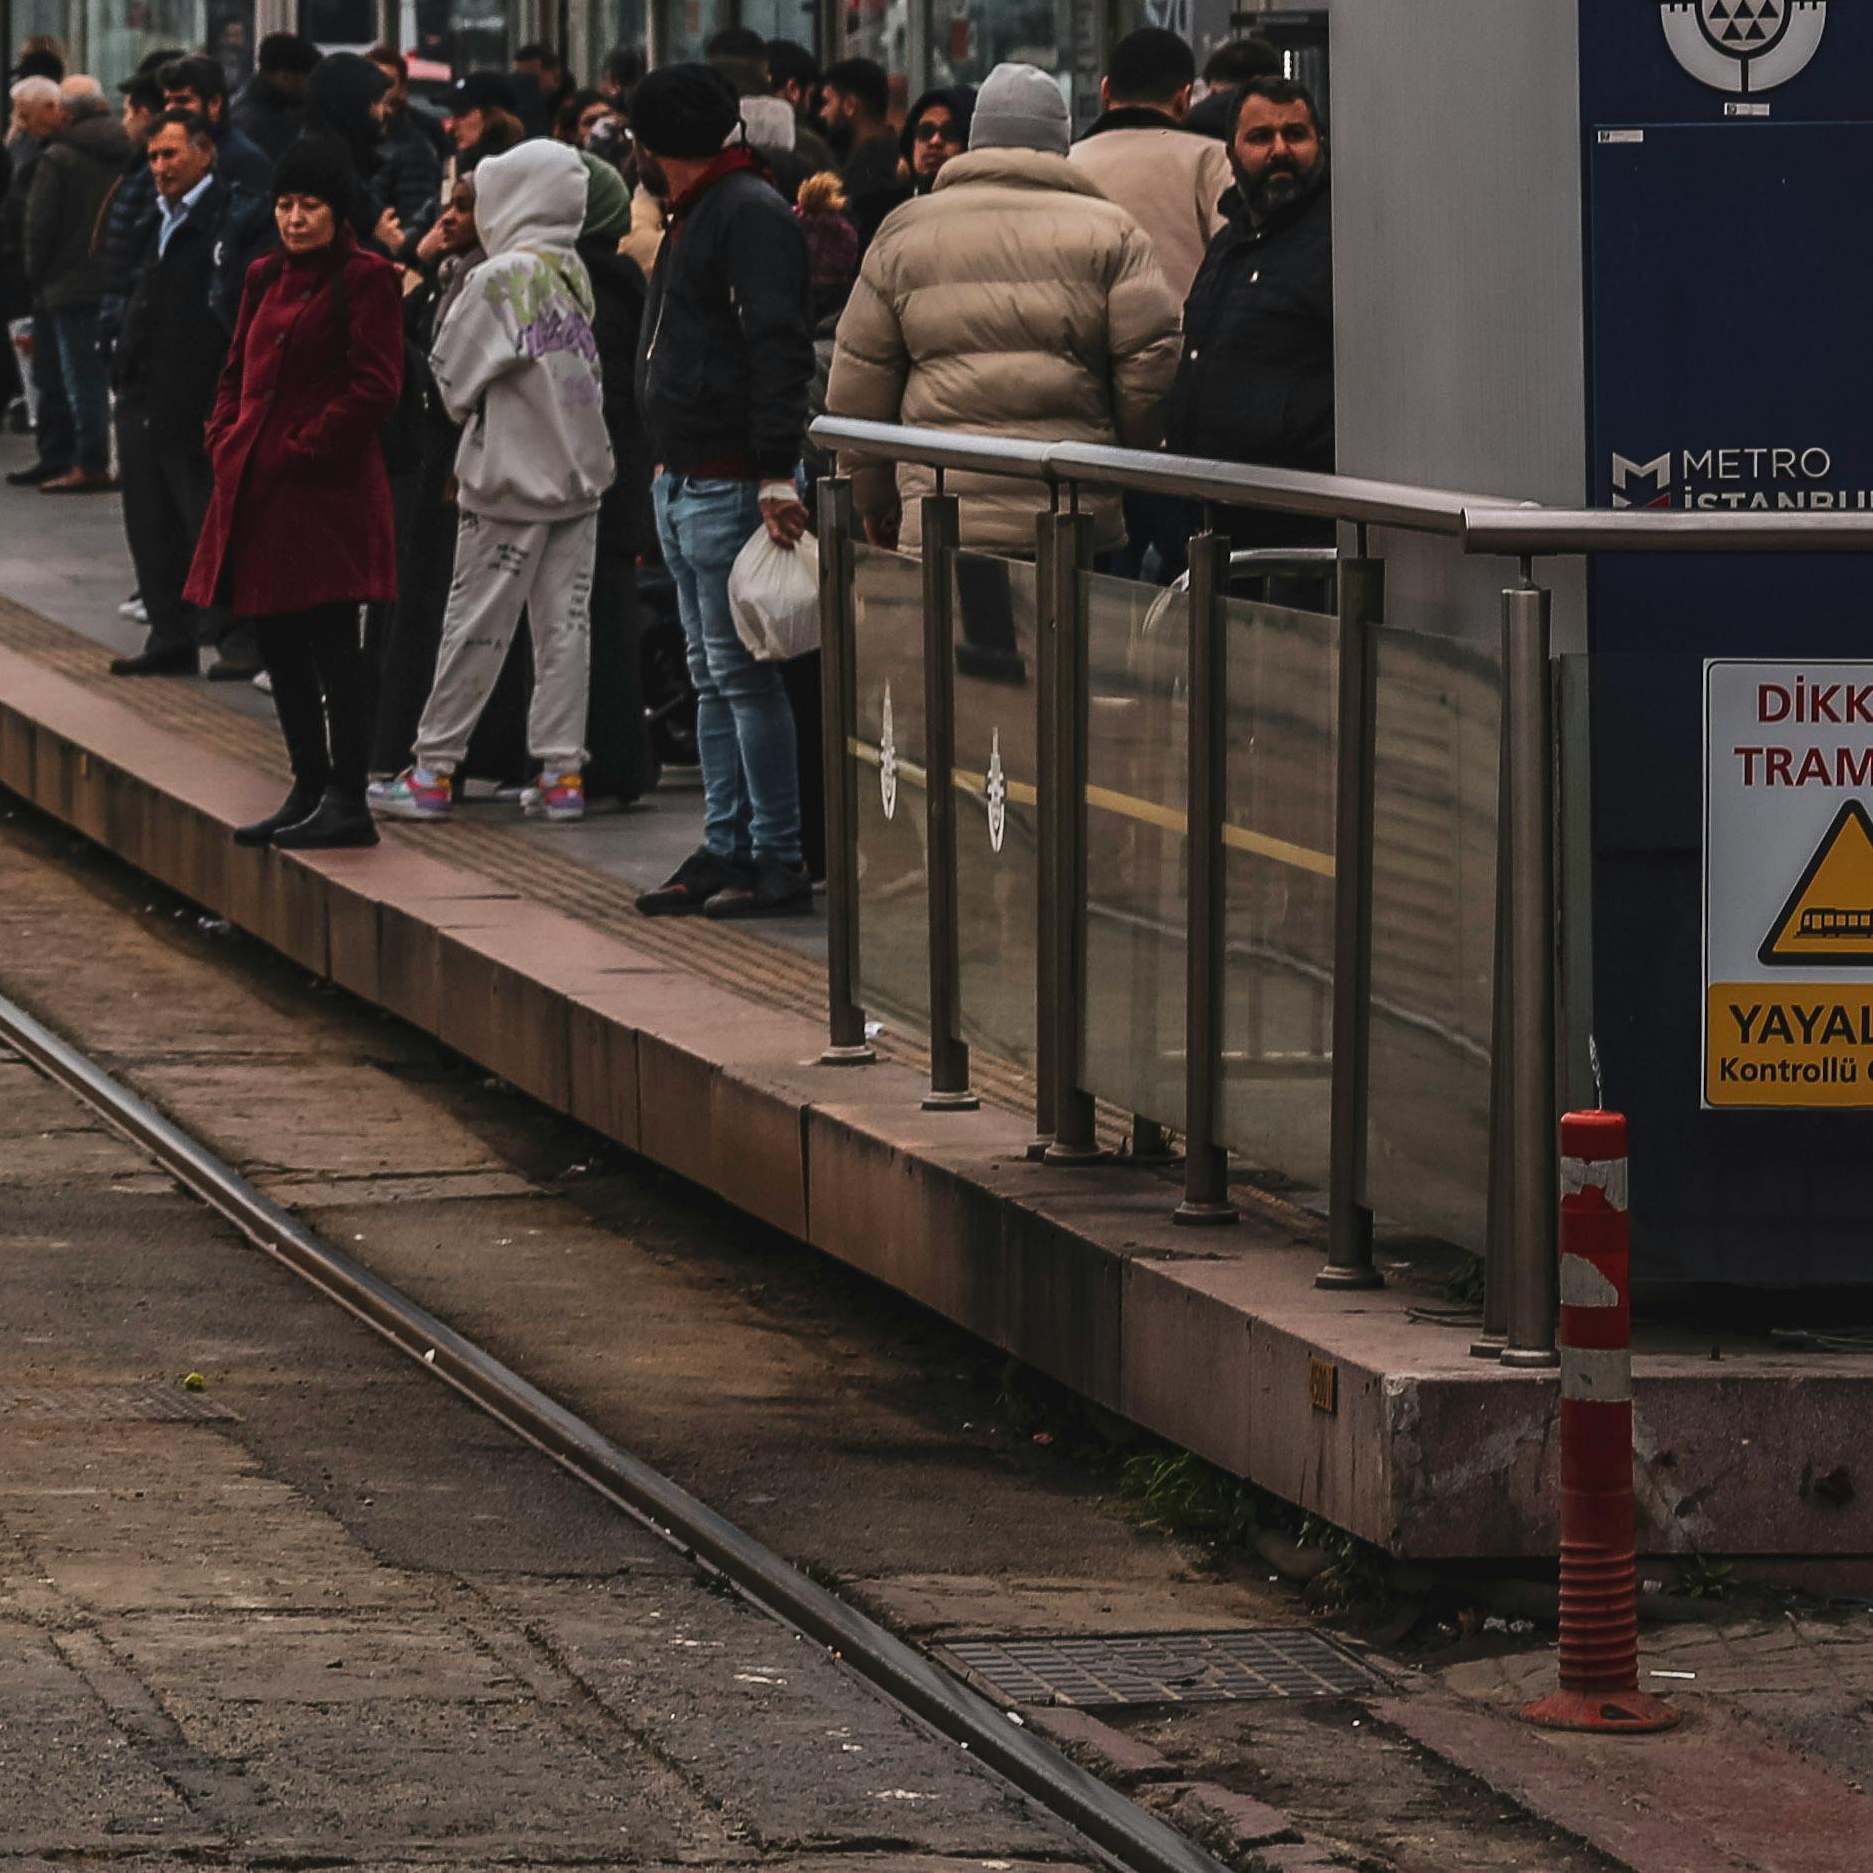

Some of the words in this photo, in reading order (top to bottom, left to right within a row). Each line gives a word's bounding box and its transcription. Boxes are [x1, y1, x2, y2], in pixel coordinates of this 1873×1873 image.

[1683, 447, 1831, 479] METRO
[1733, 747, 1873, 787] TRAM
[1720, 1056, 1857, 1083] Kontrollü
